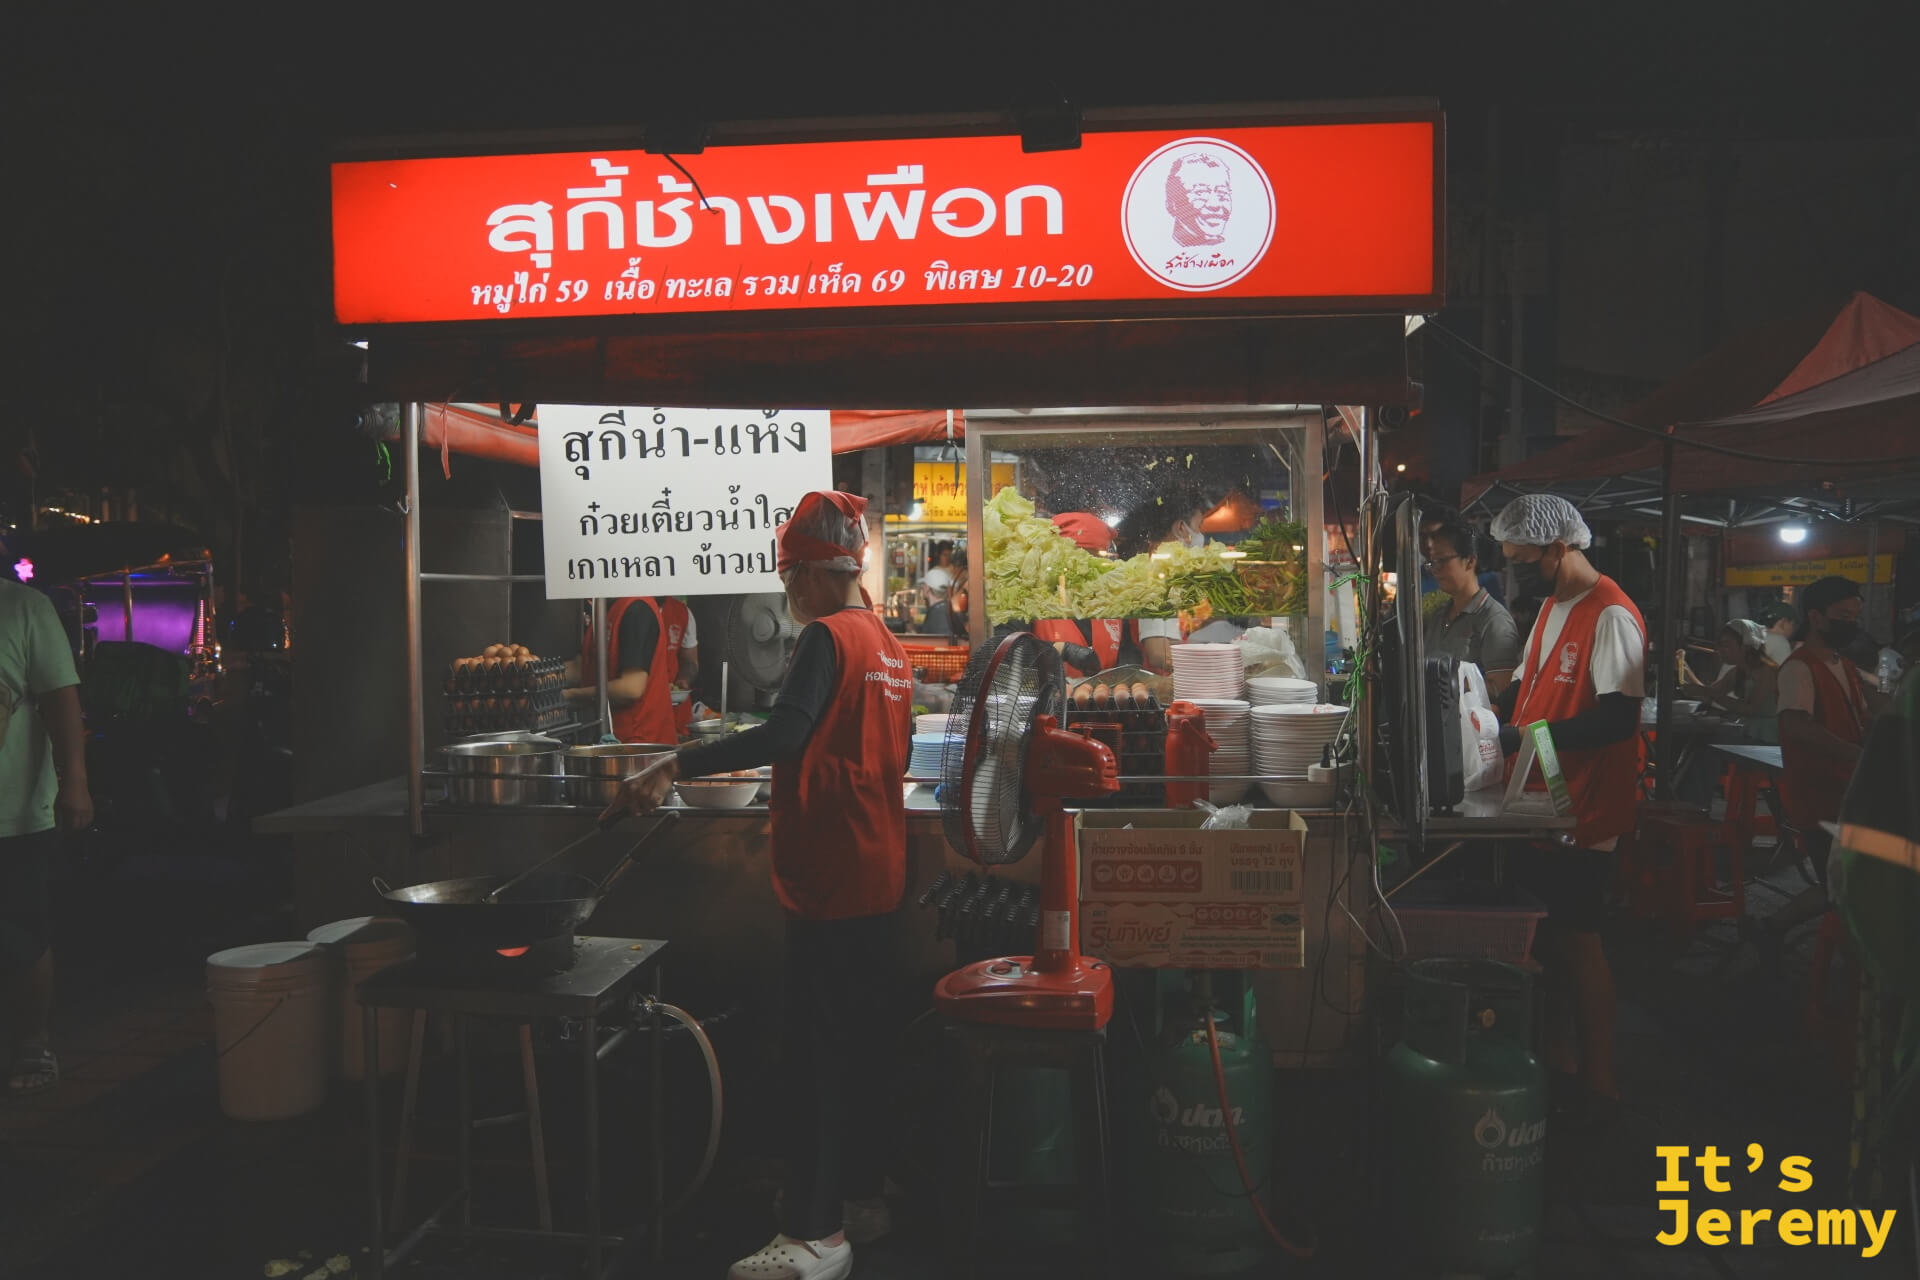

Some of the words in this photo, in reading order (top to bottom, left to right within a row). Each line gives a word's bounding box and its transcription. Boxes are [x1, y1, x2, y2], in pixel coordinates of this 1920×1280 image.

[486, 158, 1064, 269] สุกี้ช้างเผือก
[556, 280, 589, 302] 59
[872, 269, 905, 292] 69
[925, 259, 1003, 291] พิเศษ
[1012, 264, 1094, 289] 10-20
[563, 408, 807, 480] สุกีนำ-แห้ง
[568, 555, 675, 580] เกาเหลา
[693, 539, 777, 575] ข้าวเป
